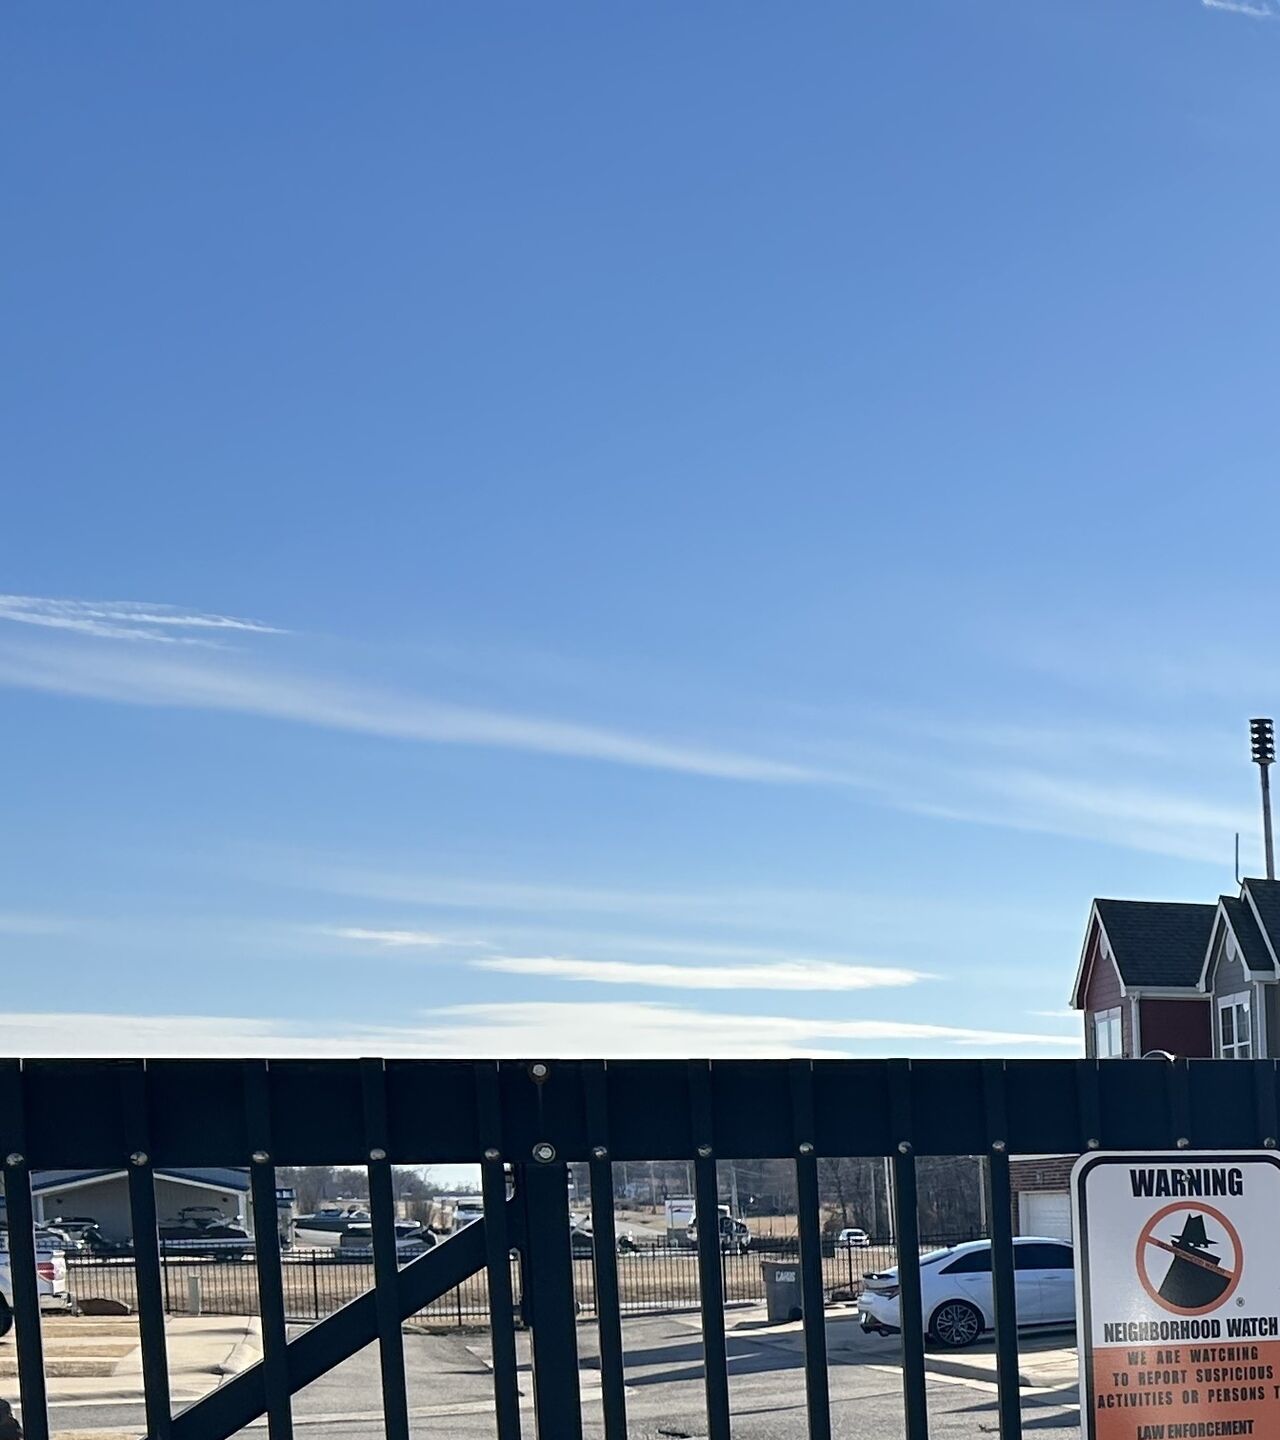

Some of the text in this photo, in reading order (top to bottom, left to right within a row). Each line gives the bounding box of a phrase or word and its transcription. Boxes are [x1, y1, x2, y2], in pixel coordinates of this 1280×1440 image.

[1130, 1168, 1244, 1198] WARNING
[1104, 1316, 1279, 1343] NEIGHBORHOOD WATCH
[1127, 1346, 1259, 1366] WE ARE WATCHING
[1112, 1365, 1274, 1387] TO REPORT SUSPICIOUS
[1097, 1391, 1173, 1409] ACTIVITIES
[1182, 1389, 1199, 1404] OR
[1208, 1387, 1265, 1403] PERSONS
[1137, 1419, 1255, 1440] LAW ENFORCEMENT
